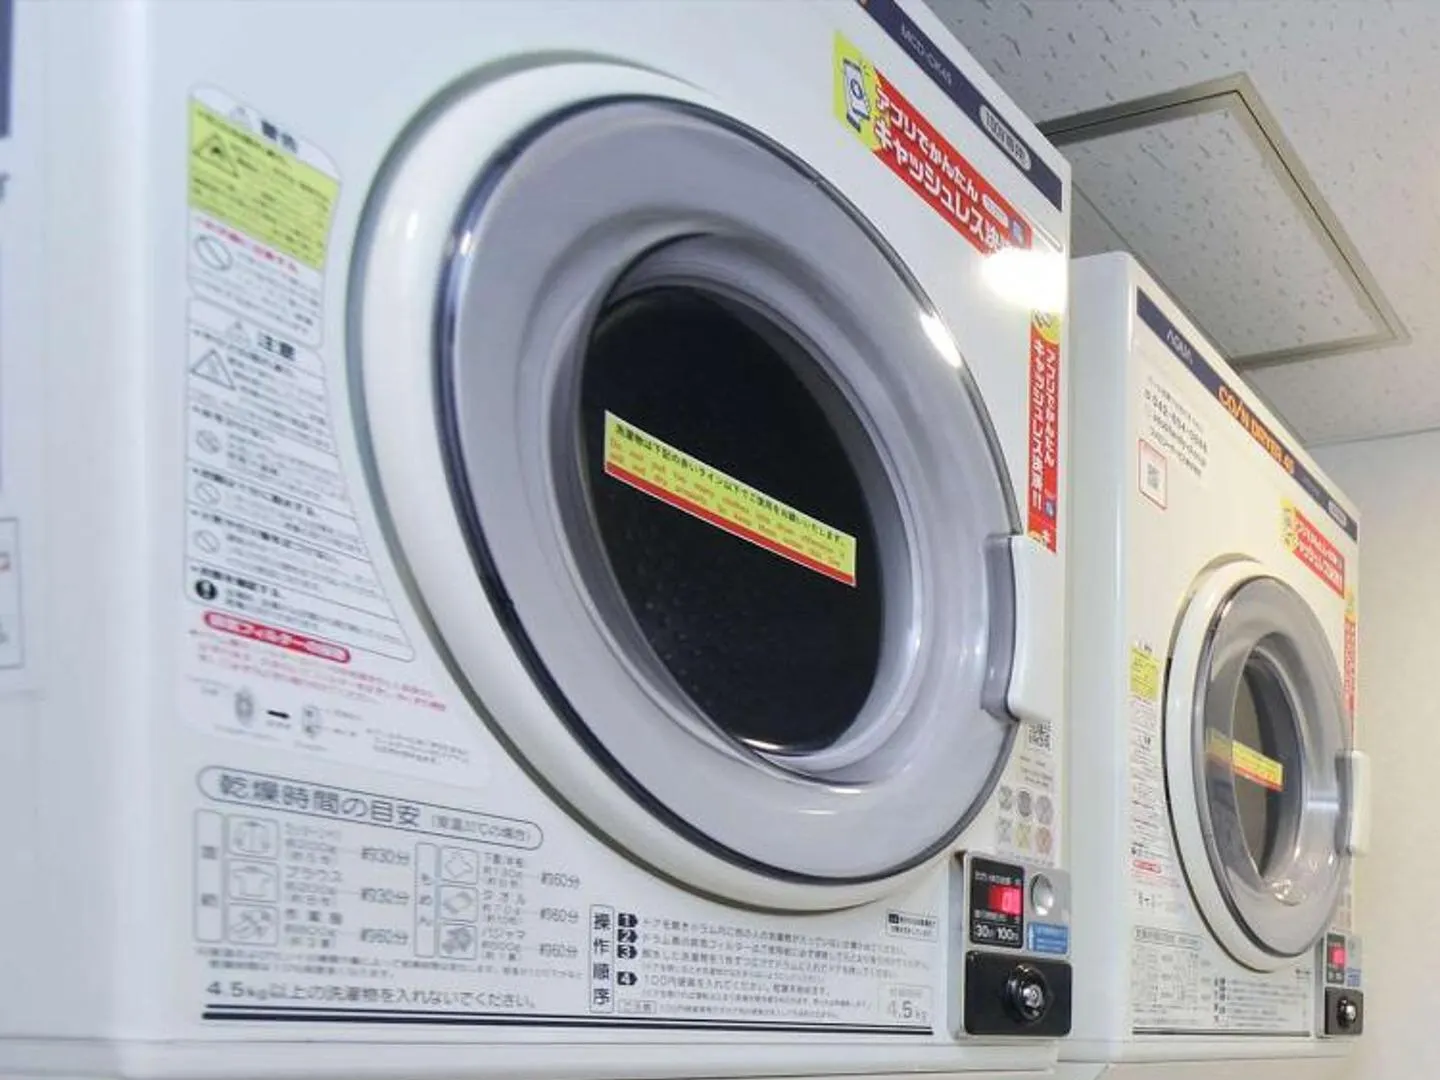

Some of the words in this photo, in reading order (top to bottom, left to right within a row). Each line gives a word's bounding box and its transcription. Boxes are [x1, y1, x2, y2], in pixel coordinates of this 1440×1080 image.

[876, 86, 979, 203] アプリでかんたん
[219, 773, 421, 828] 乾燥時間の目安
